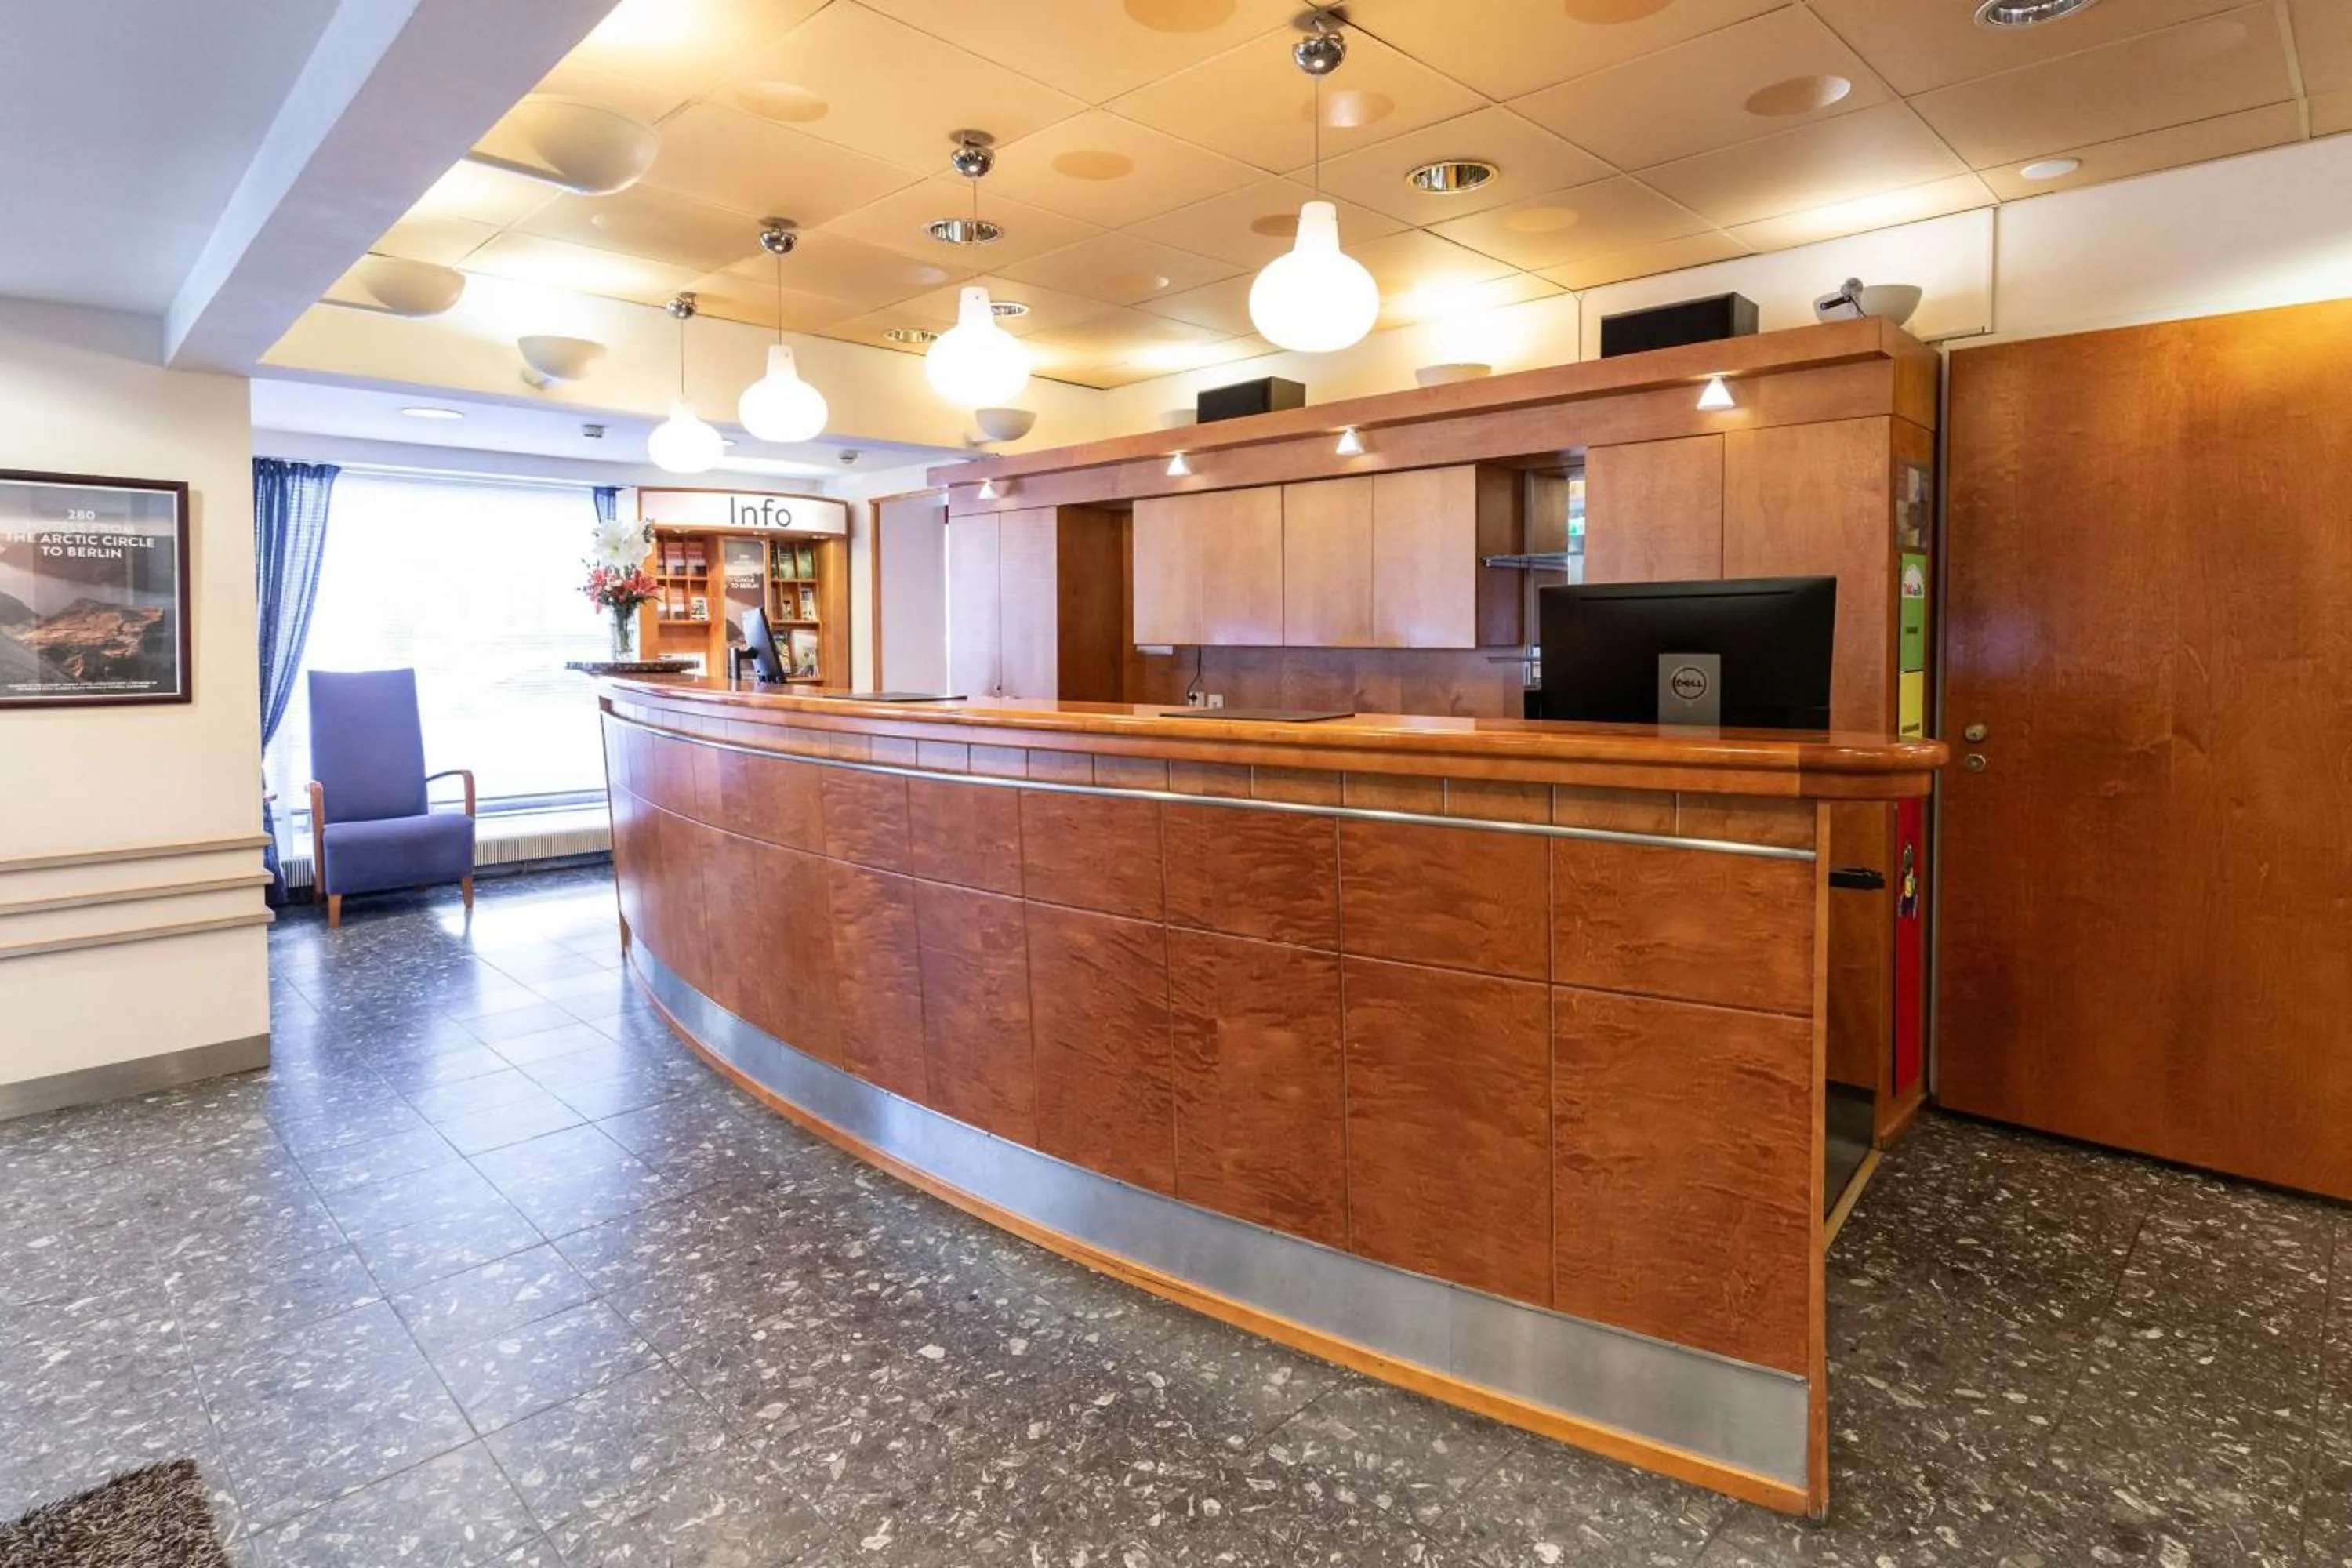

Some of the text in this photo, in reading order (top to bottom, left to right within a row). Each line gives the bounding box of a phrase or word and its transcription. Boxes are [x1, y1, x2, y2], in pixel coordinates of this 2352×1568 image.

[67, 509, 96, 521] 280
[730, 496, 792, 528] Info
[5, 532, 156, 548] THE ARCTIC CIRCLE
[41, 546, 122, 558] TO BERLIN
[1676, 678, 1703, 688] DELL
